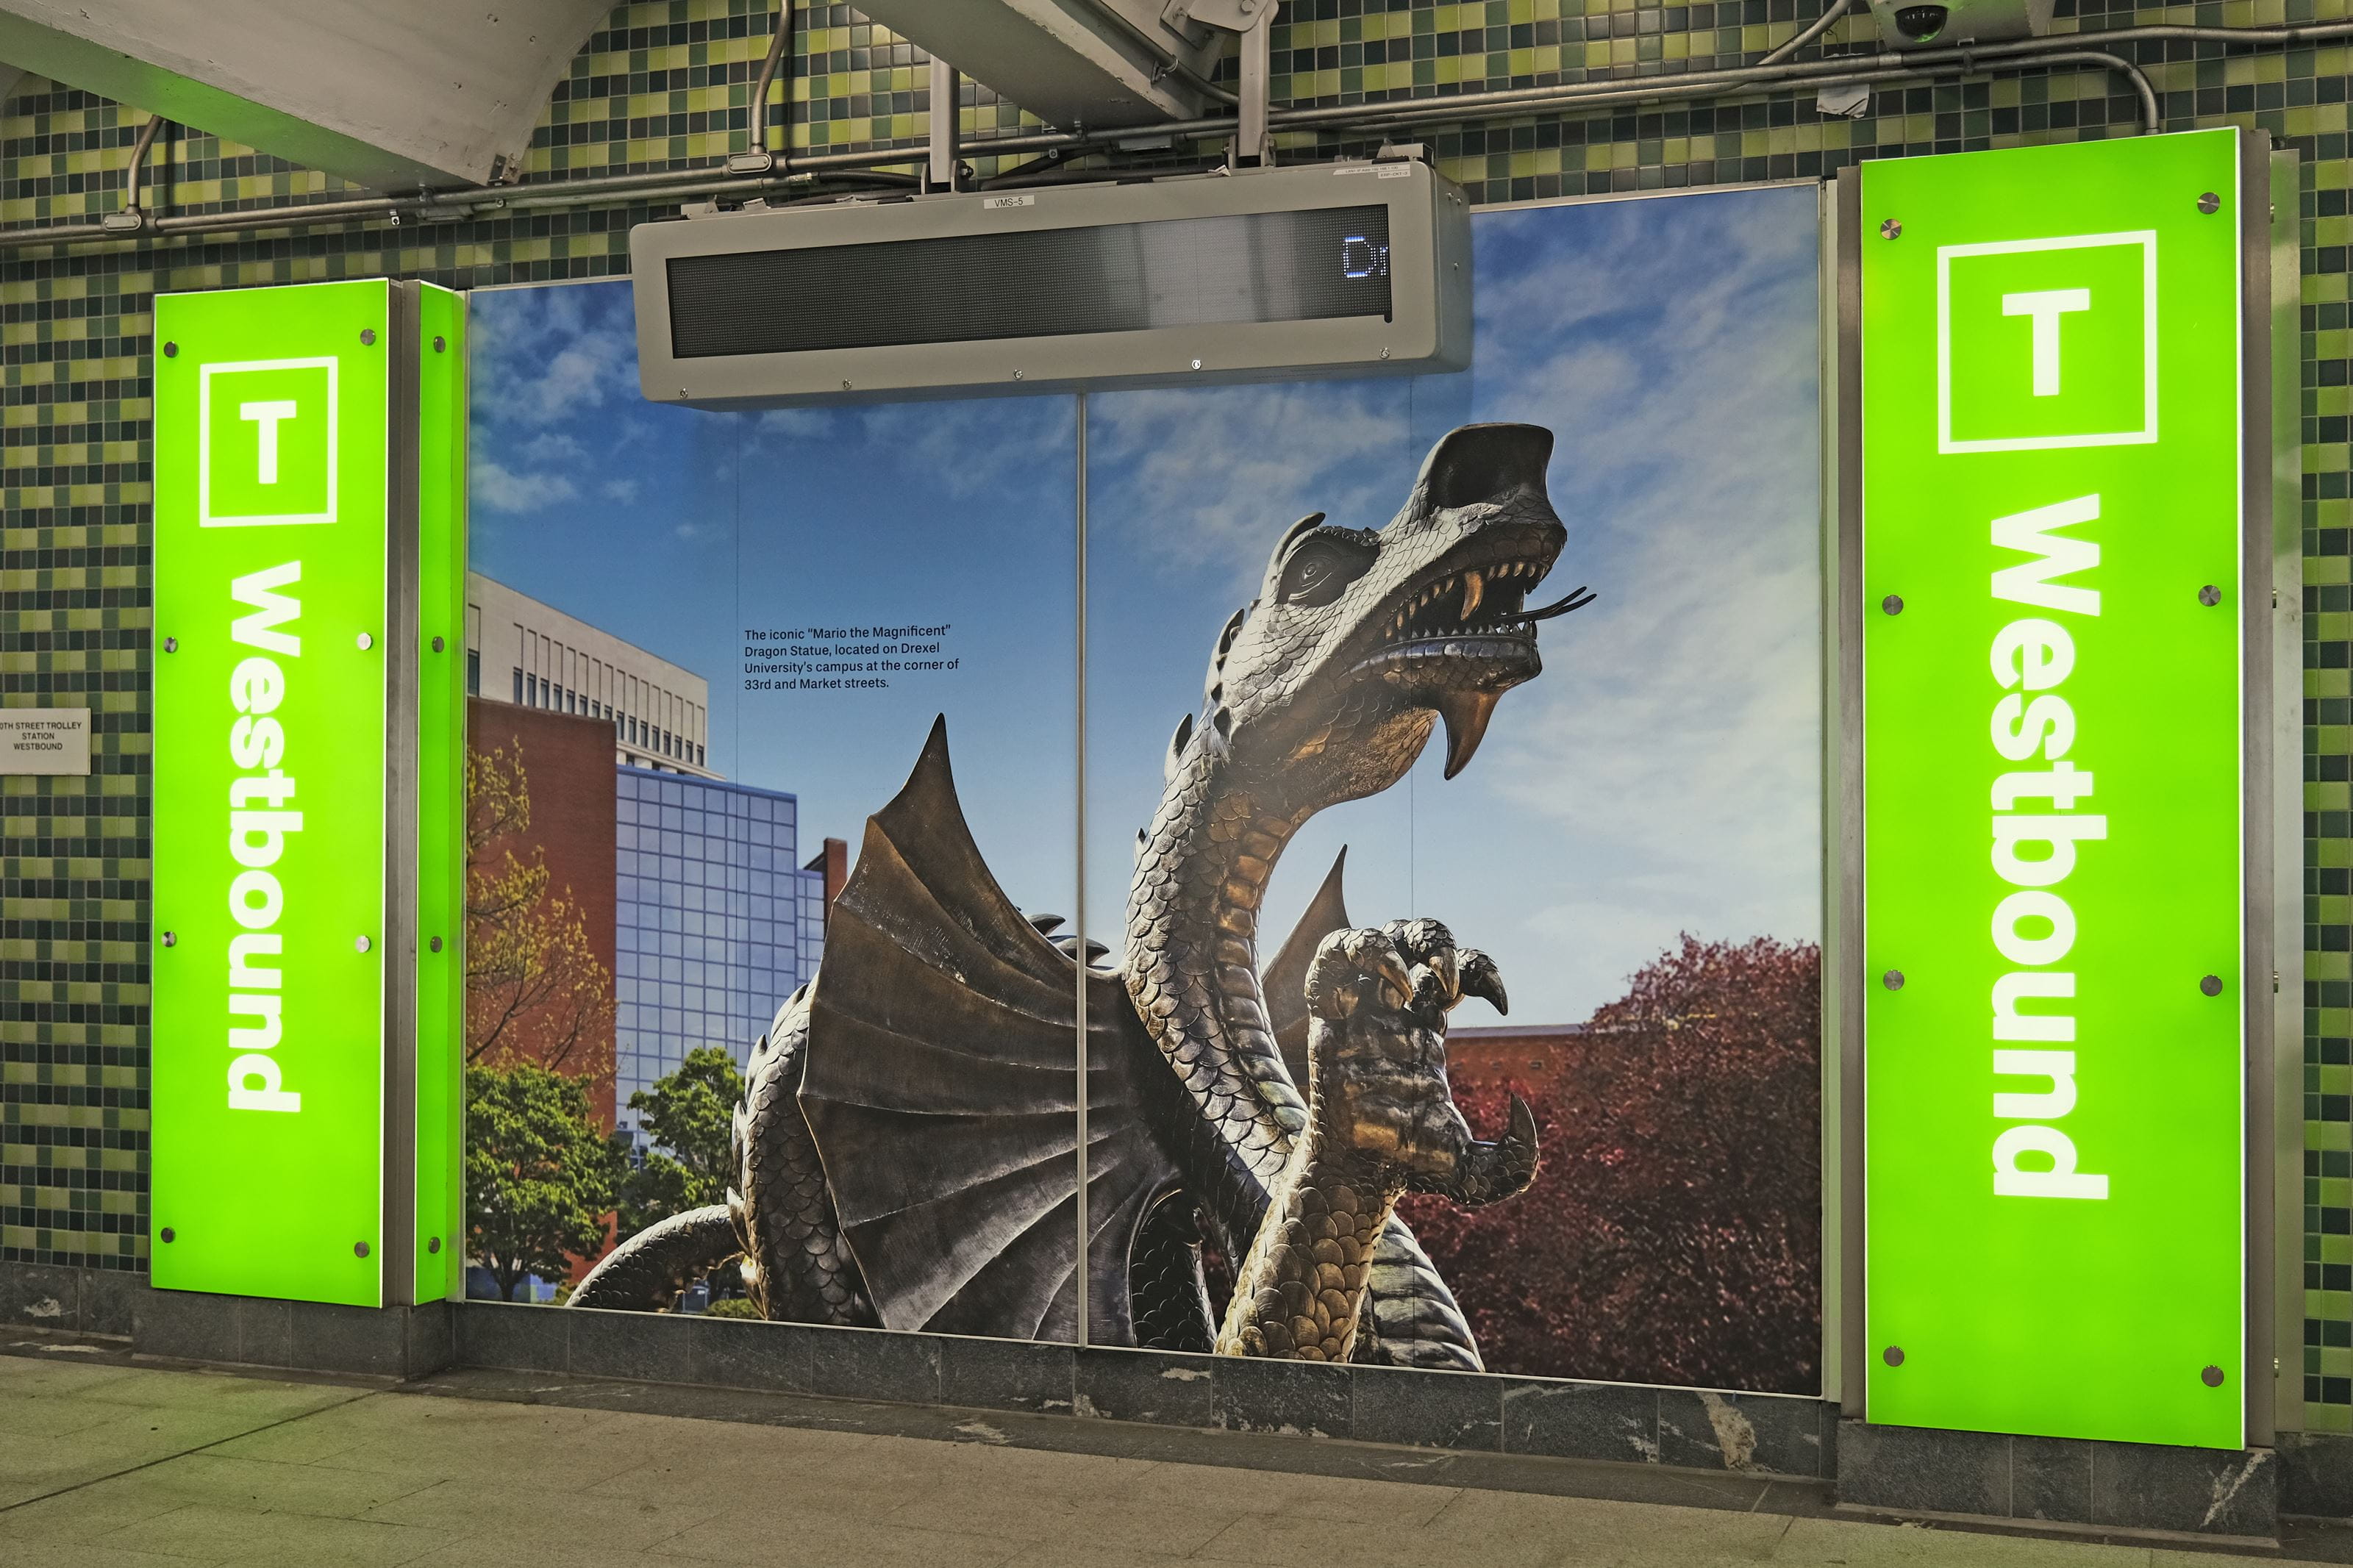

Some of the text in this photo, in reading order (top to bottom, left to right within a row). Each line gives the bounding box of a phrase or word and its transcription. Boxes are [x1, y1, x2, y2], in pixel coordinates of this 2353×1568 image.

[994, 197, 1024, 207] VMS-5
[2002, 288, 2090, 396] T
[240, 400, 296, 484] T
[745, 630, 766, 640] The
[769, 629, 804, 640] iconic
[850, 627, 869, 637] the
[745, 642, 940, 659] Dragon Statue, located on Drexel
[815, 662, 863, 674] campus
[866, 660, 878, 671] at
[881, 659, 901, 670] the
[904, 659, 943, 670] corner
[947, 659, 960, 670] of
[744, 678, 889, 690] 33rd and Market streets.
[15, 722, 45, 730] STREET
[227, 560, 304, 1112] Westbound
[1990, 493, 2109, 1200] Westbound
